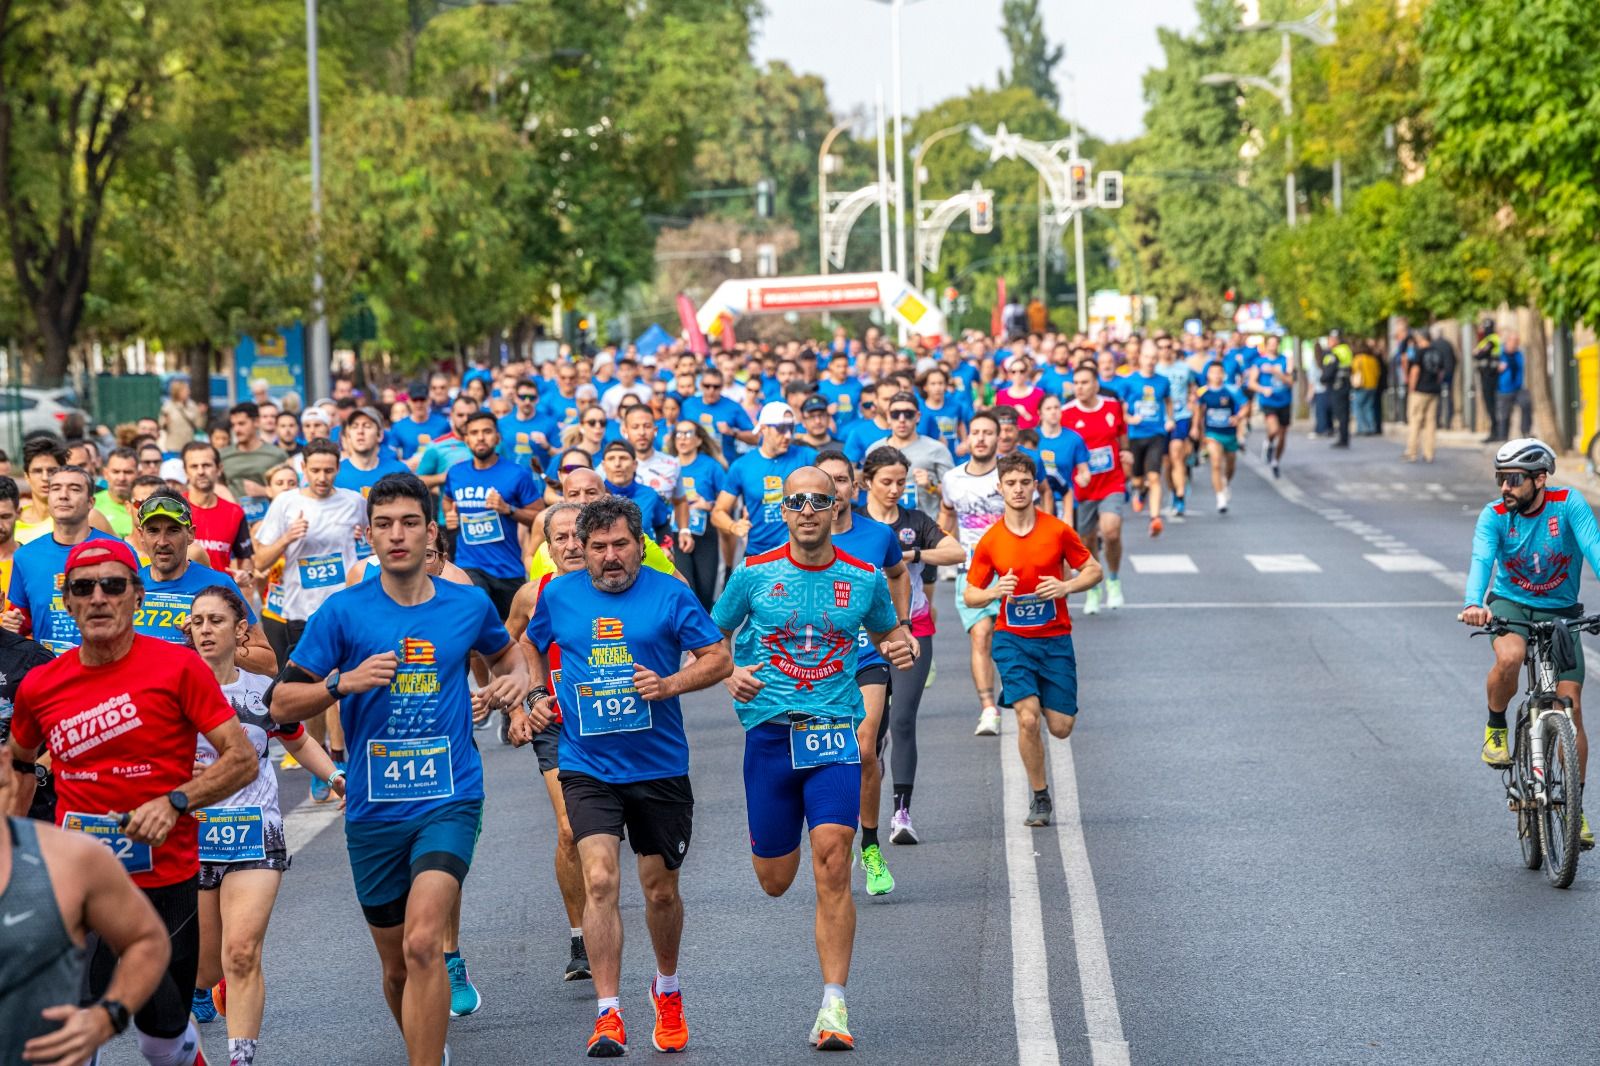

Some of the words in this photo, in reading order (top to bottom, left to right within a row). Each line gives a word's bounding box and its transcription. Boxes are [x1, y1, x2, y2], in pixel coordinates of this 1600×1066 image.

[467, 521, 494, 536] 806
[306, 563, 338, 580] 923
[834, 582, 851, 591] SWIM
[835, 590, 850, 599] BIKE
[836, 598, 848, 607] RUN
[1014, 603, 1045, 617] 627
[133, 609, 186, 628] 2724
[591, 643, 627, 657] MUÉVETE
[587, 656, 593, 666] X
[595, 653, 633, 666] VALENCIA
[396, 670, 437, 683] MUÉVETE
[390, 681, 397, 694] X
[399, 681, 441, 694] VALENCIA
[592, 696, 637, 717] 192
[805, 732, 845, 751] 610
[384, 758, 437, 782] 414
[205, 824, 251, 845] 497
